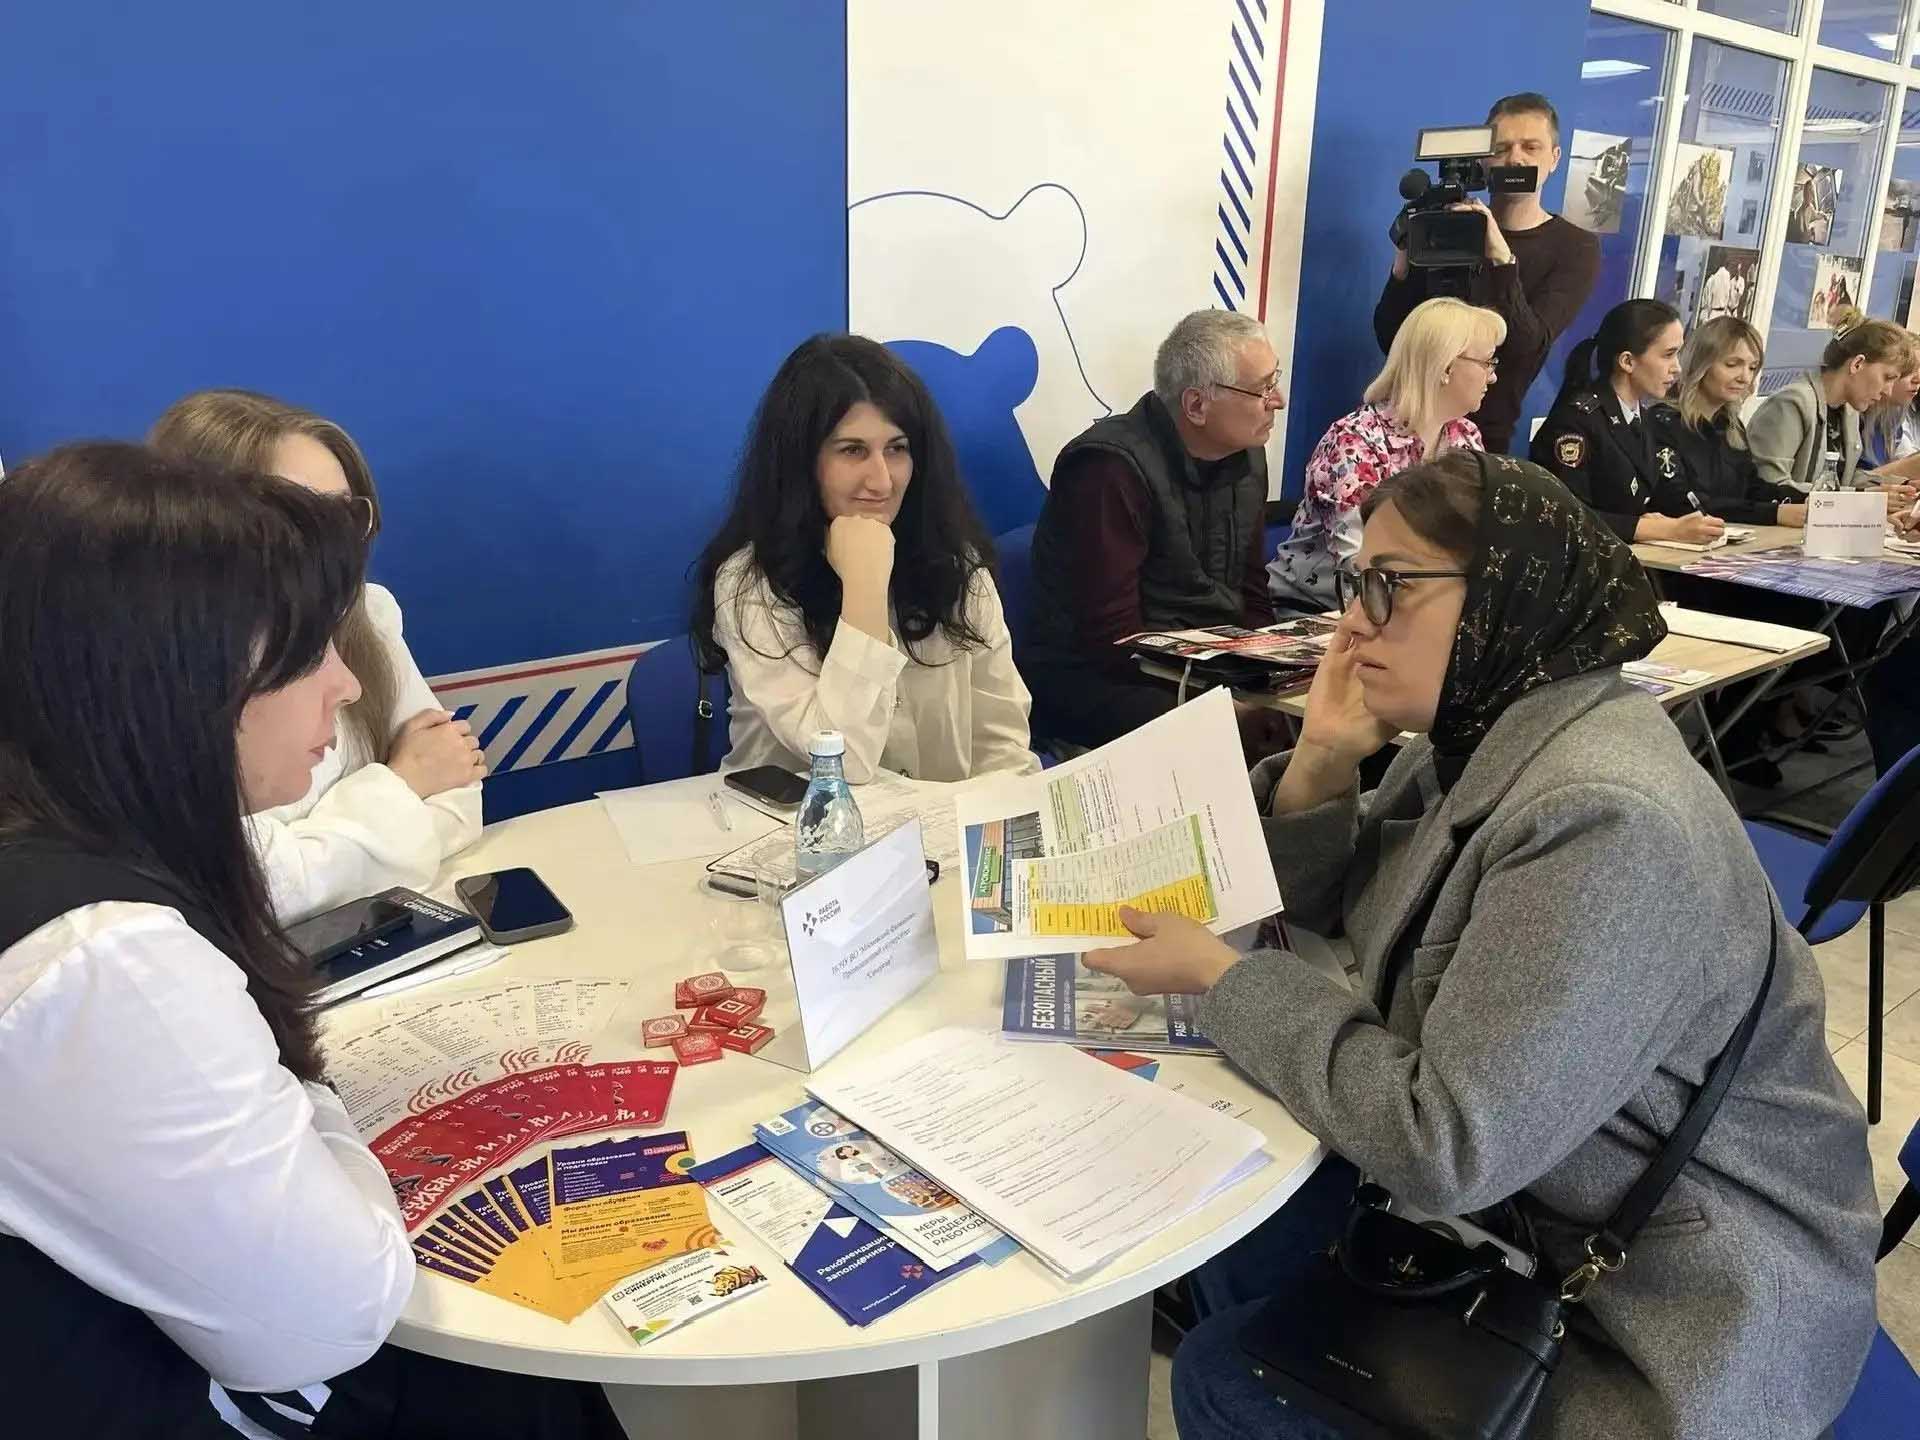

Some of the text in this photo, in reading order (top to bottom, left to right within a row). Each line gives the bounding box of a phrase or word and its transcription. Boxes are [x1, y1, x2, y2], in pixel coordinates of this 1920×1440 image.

[819, 899, 839, 914] РАБОТА
[820, 906, 841, 923] РОССИИ
[1030, 957, 1057, 1030] БЕЗОПАСНЫЙ
[556, 1152, 636, 1168] Уровни образования
[563, 1161, 608, 1171] подготовки
[914, 1215, 949, 1232] МЕРЫ
[625, 1273, 667, 1295] СИНЕРГИЯ
